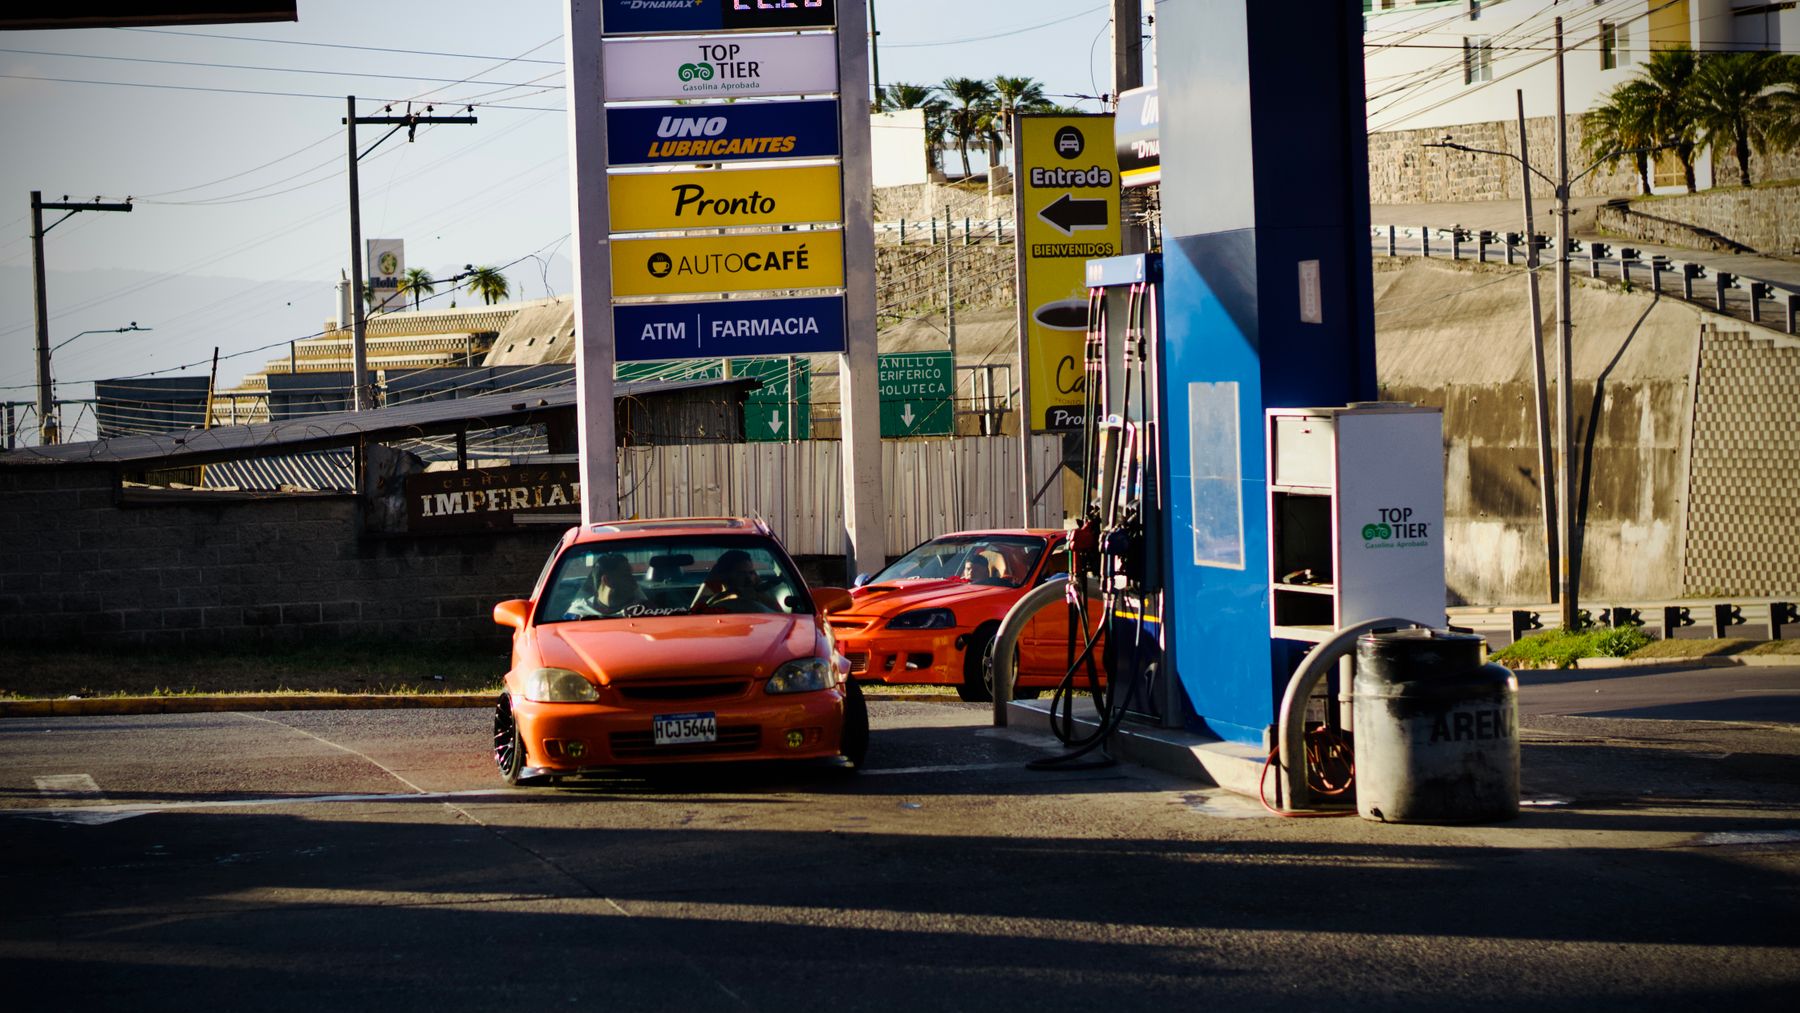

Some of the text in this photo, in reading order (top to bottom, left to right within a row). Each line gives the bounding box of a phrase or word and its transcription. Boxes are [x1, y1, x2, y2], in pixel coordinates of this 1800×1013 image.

[698, 44, 741, 62] TOP
[715, 61, 760, 79] TIER
[682, 81, 760, 92] Gasolina Aprobada
[1141, 94, 1159, 126] UN
[656, 116, 728, 138] UNO
[647, 135, 797, 158] LUBRICANTES
[1031, 165, 1112, 186] Entrada
[671, 183, 776, 217] Pronto
[677, 241, 809, 276] AUTOCAFÉ
[1033, 242, 1113, 257] BIENVENIDOS
[640, 317, 819, 341] ATM FARMACIA
[880, 356, 934, 368] ANILLO
[879, 368, 941, 381] ERIFERICO
[1056, 355, 1086, 394] Ca
[879, 382, 946, 395] HOLUTECA
[1378, 507, 1413, 523] TOP
[1392, 522, 1428, 539] TIER
[655, 718, 715, 739] HCJ5644
